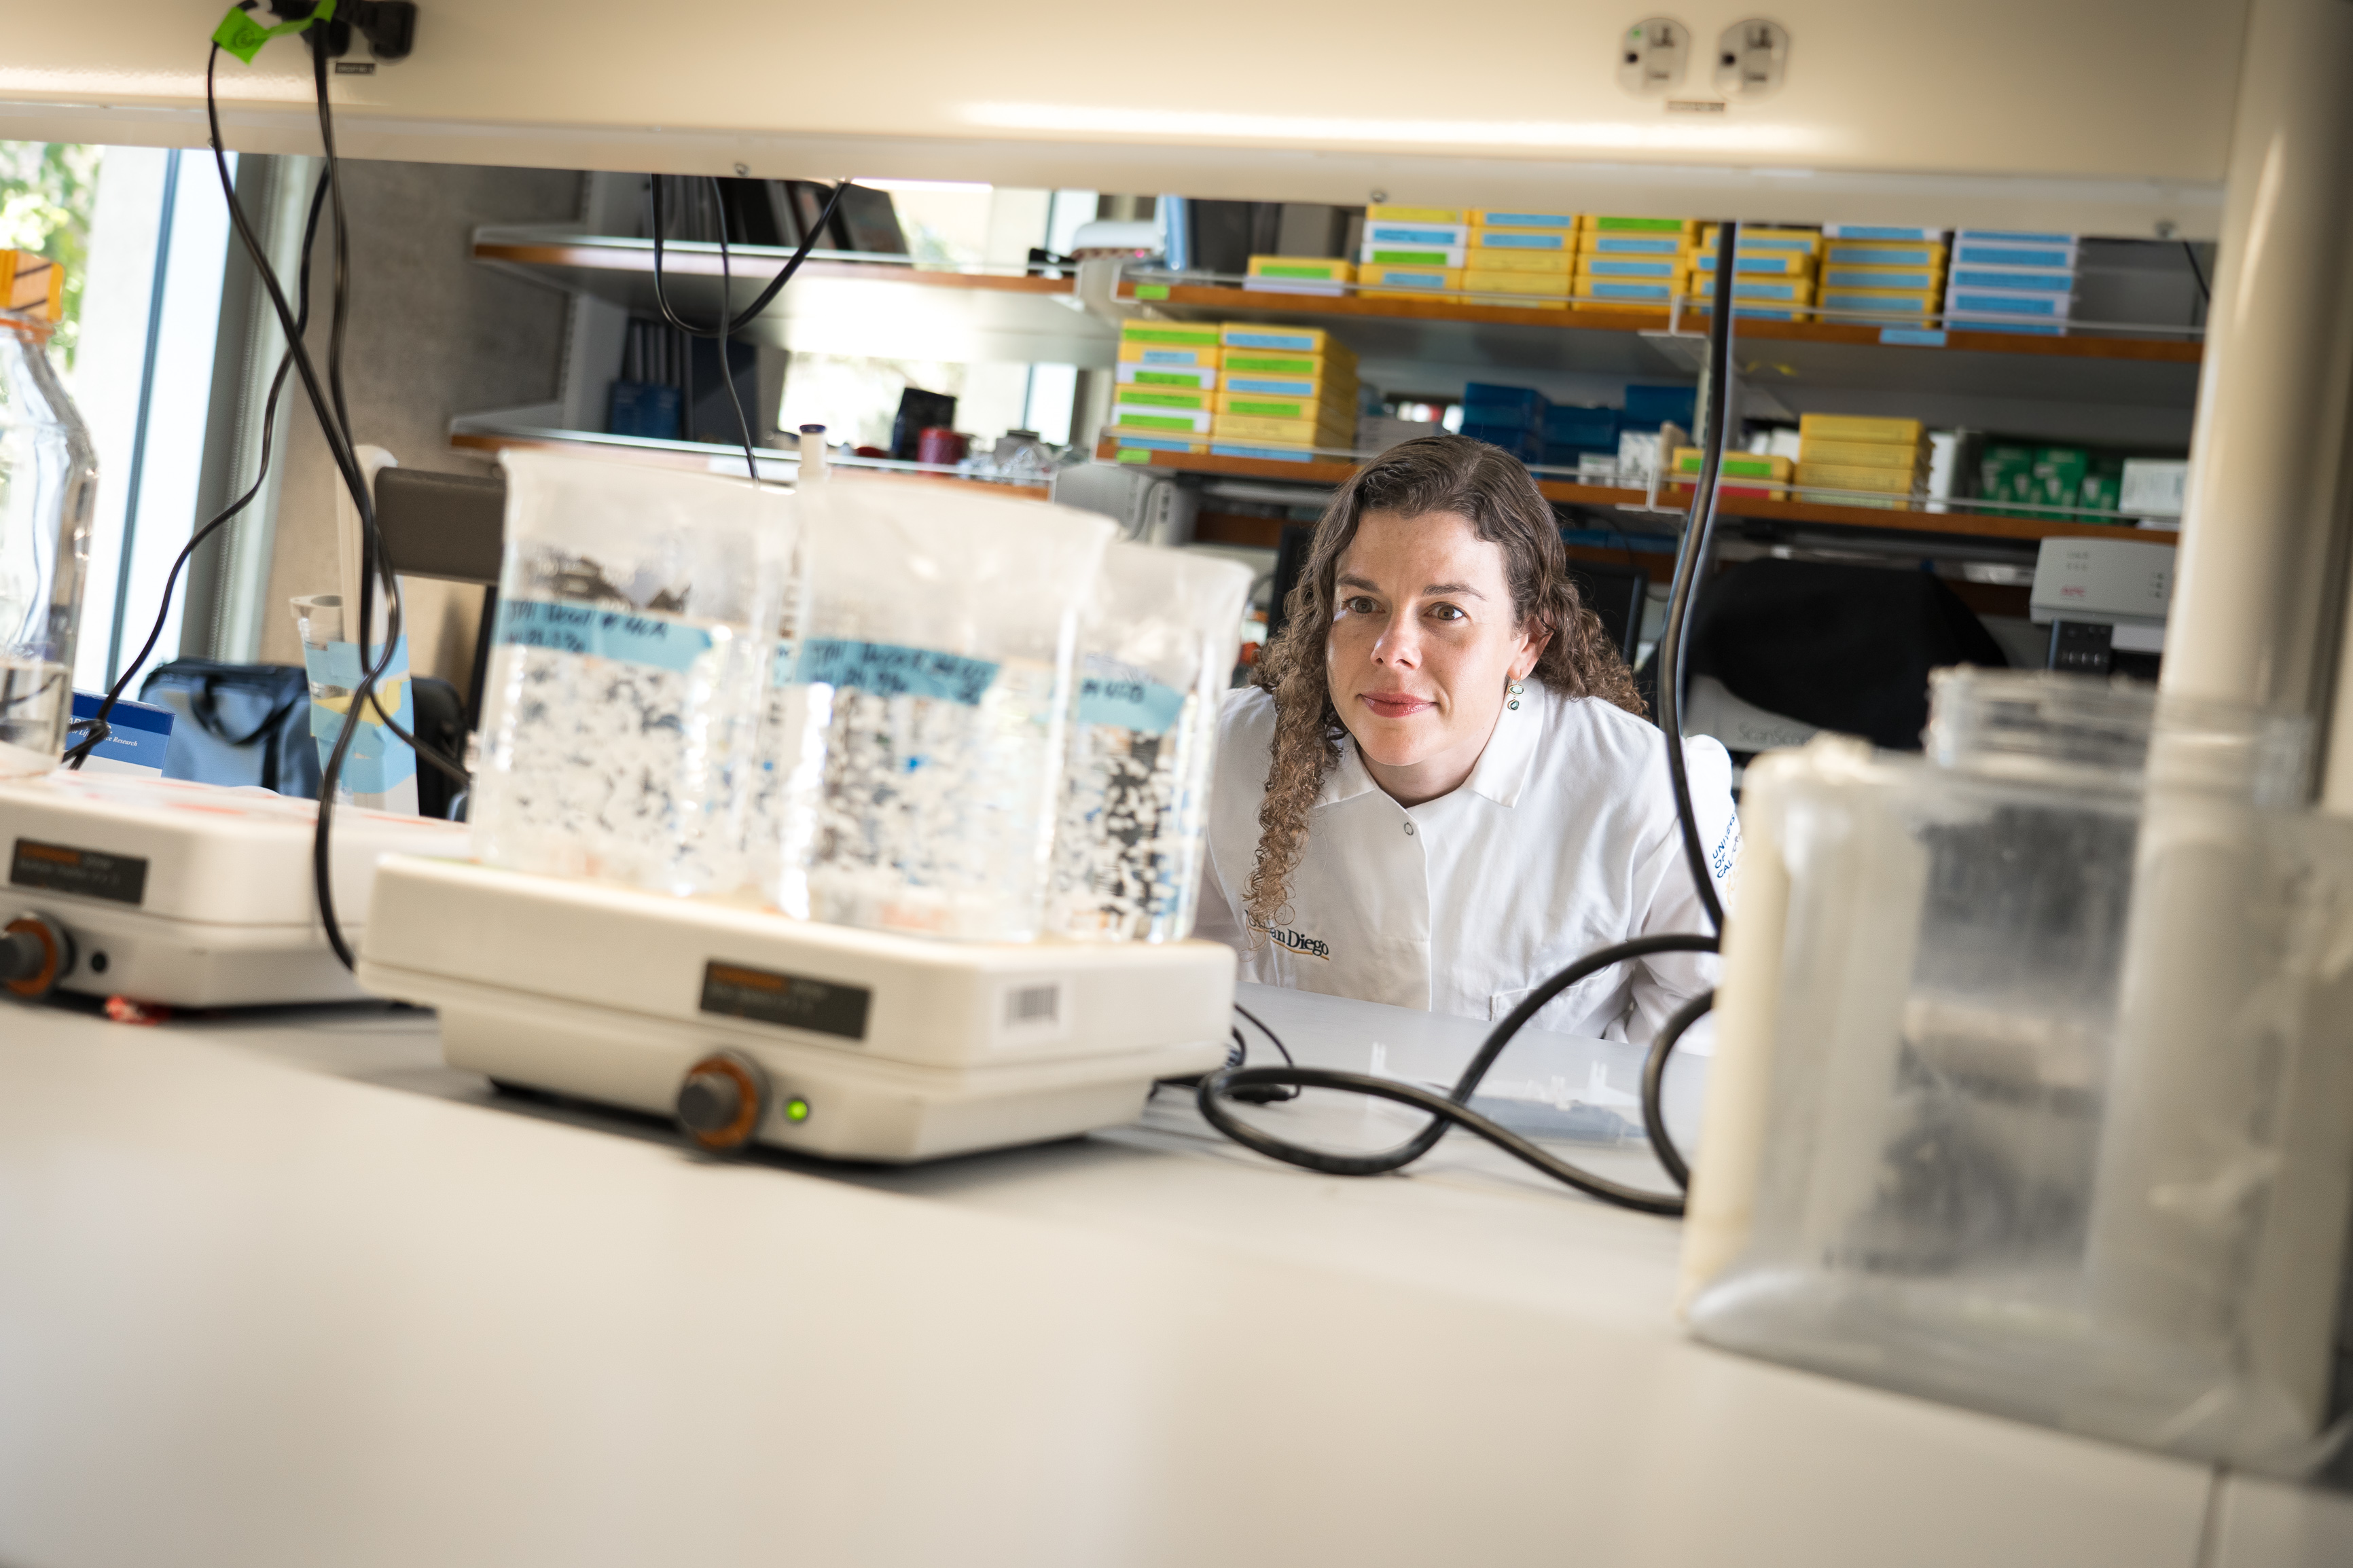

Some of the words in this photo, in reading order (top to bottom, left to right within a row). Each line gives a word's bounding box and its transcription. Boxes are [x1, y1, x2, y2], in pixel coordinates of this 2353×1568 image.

[113, 736, 138, 746] Research
[1714, 852, 1725, 869] OF
[1287, 928, 1329, 956] Diego
